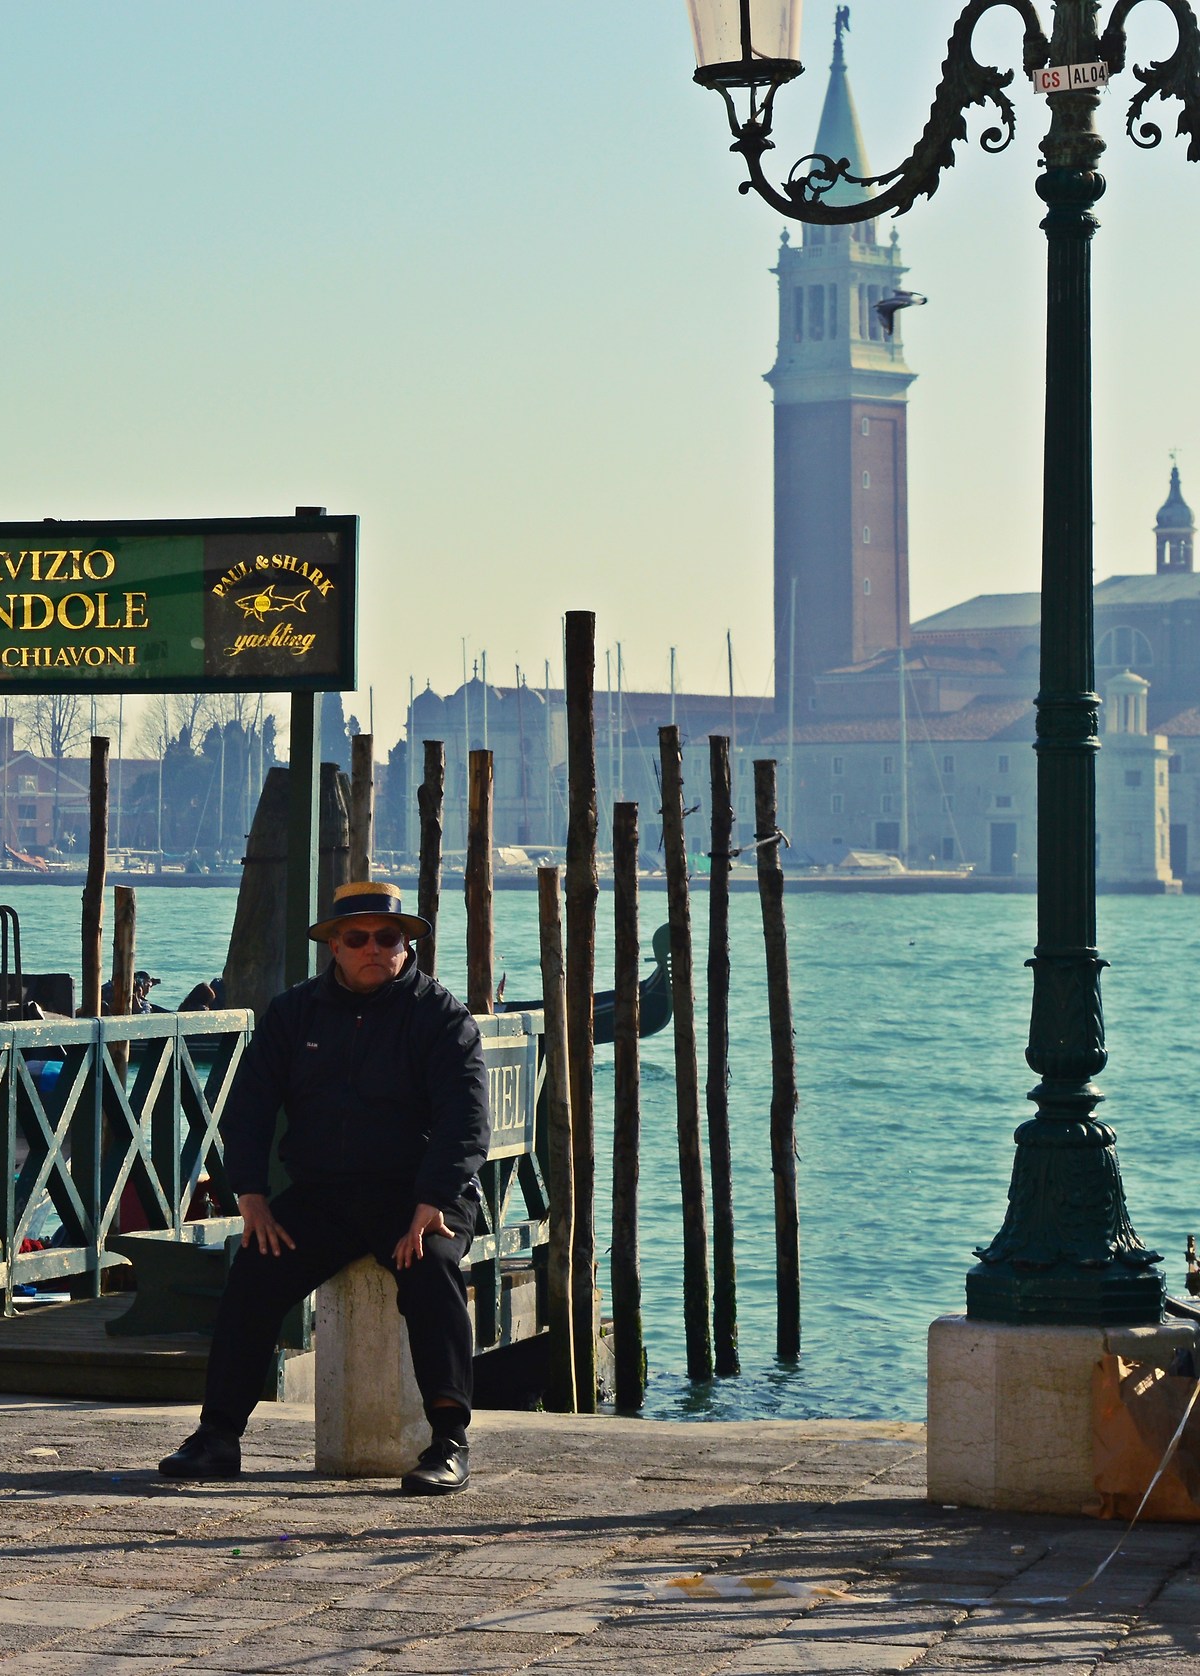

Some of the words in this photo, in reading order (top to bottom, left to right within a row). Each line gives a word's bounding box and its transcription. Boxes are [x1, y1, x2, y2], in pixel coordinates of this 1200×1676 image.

[1042, 72, 1060, 88] CS
[212, 561, 252, 597] PAUL
[255, 555, 269, 570] &
[272, 554, 335, 597] SHARK
[223, 622, 316, 656] yachting
